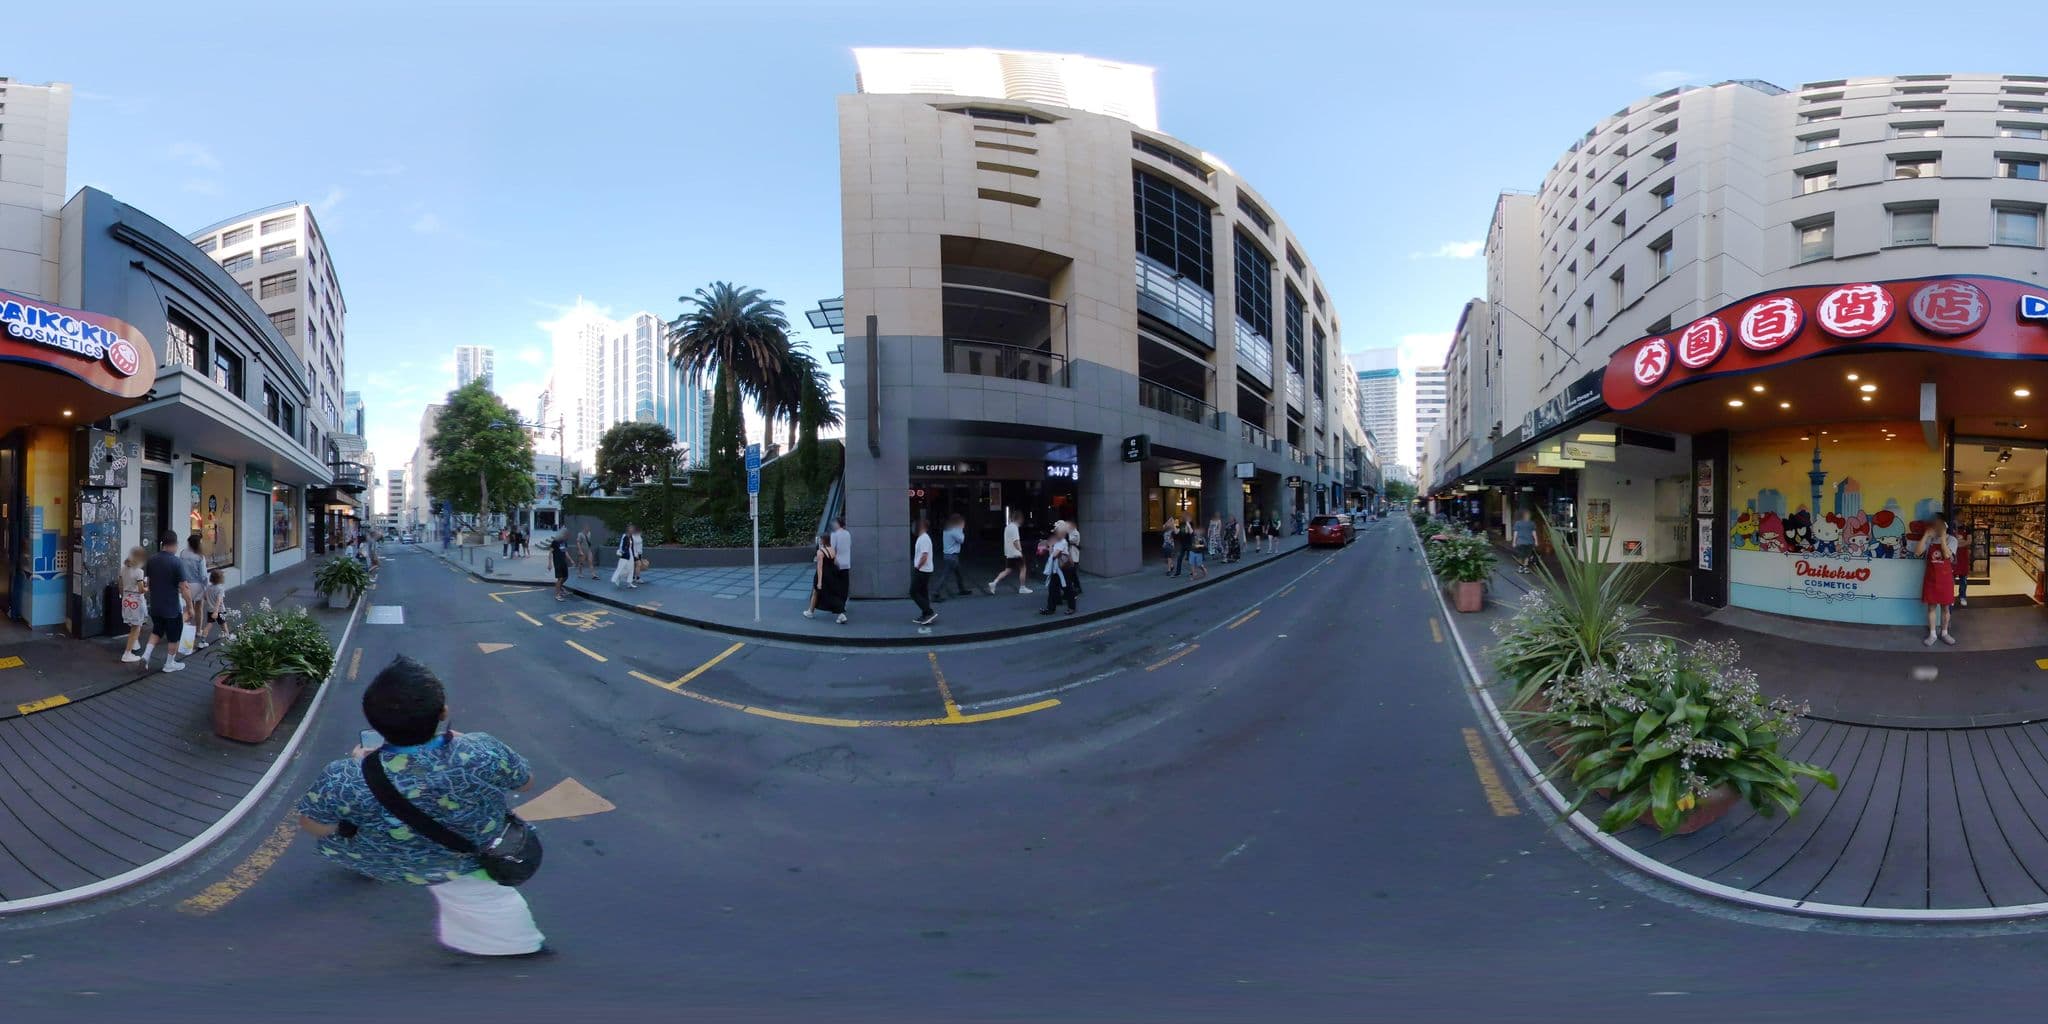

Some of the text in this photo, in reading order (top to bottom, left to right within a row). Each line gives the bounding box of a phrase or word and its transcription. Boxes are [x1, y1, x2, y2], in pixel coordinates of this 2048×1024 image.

[0, 301, 118, 349] AIKOKU
[9, 323, 103, 358] COSMETICS
[1047, 465, 1070, 477] 24/7
[1795, 560, 1857, 580] Daikoku
[1804, 579, 1858, 590] COSMETICS
